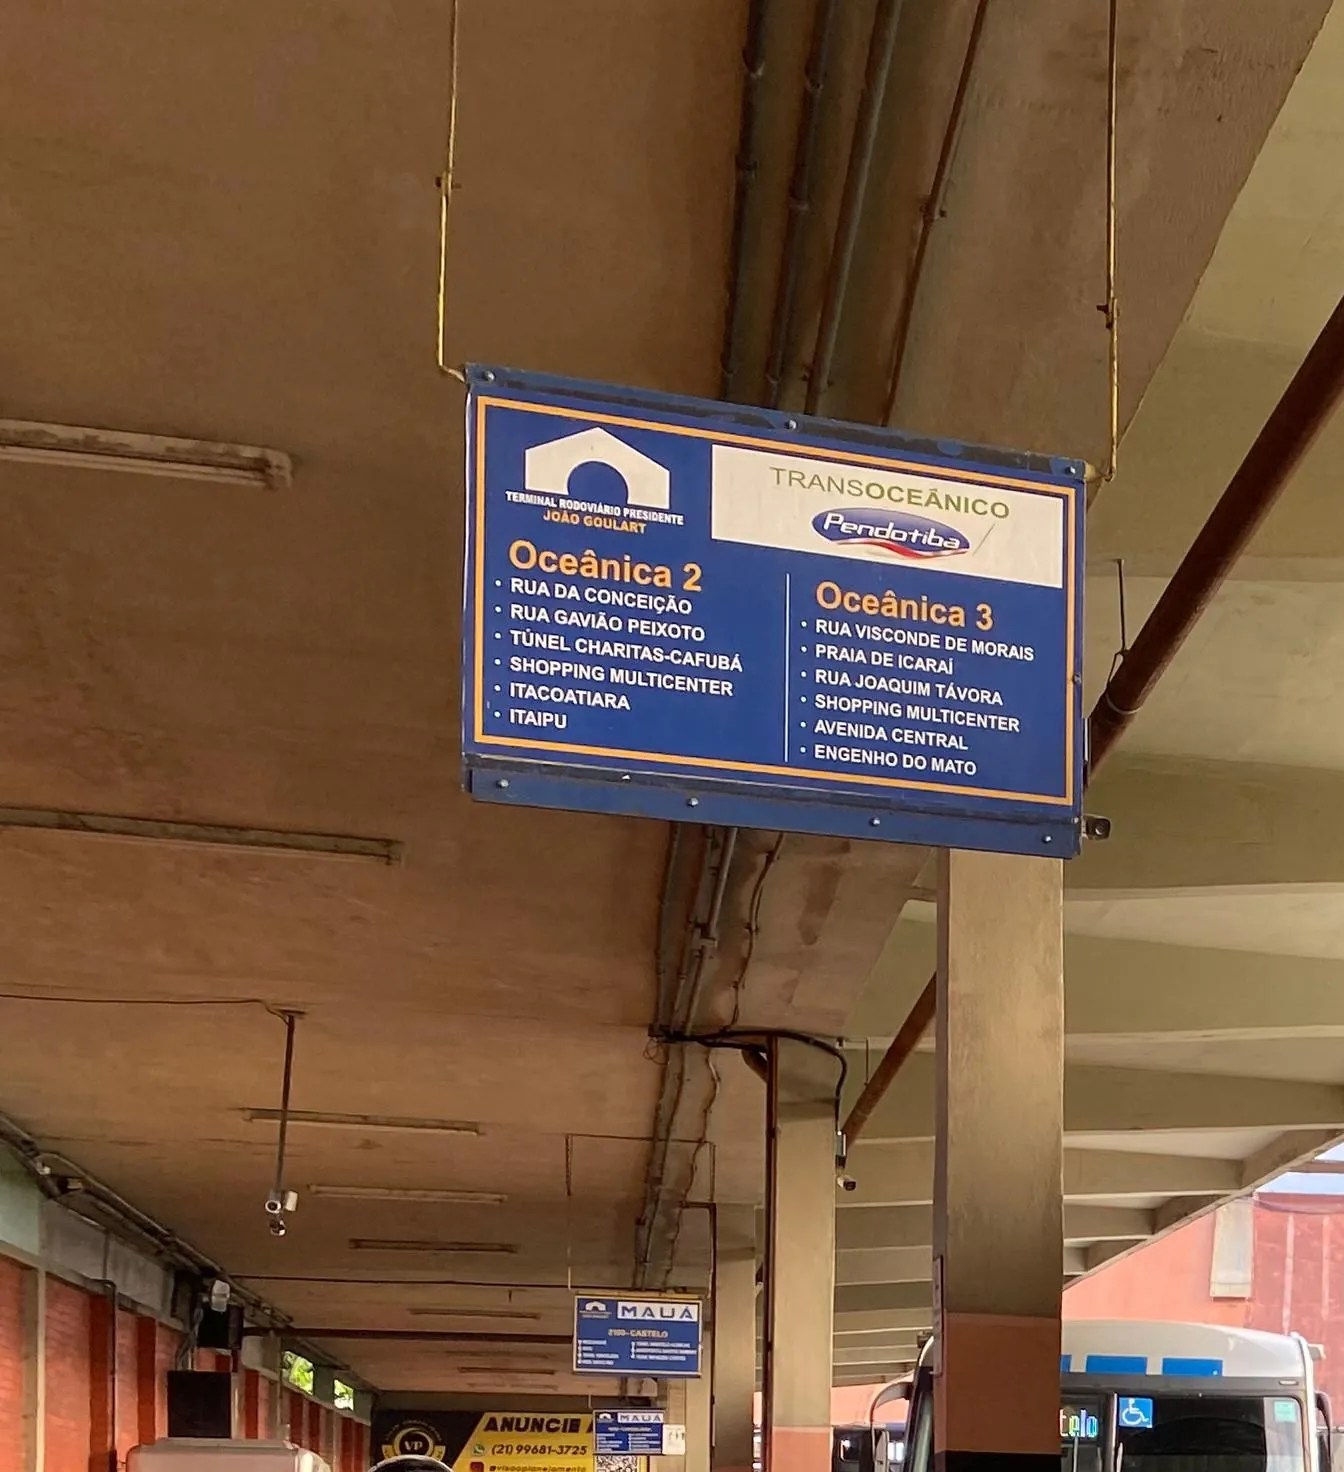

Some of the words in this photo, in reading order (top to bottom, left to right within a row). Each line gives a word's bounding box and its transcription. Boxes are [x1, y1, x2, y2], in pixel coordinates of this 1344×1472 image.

[505, 490, 557, 508] TERMINAL
[559, 498, 621, 517] RODOVIÁRIO
[623, 507, 684, 526] PRESIDENTE
[769, 466, 1010, 519] TRANSOCEÂNICO
[543, 509, 580, 526] JOÃO
[583, 515, 647, 534] GOULART
[823, 512, 961, 550] Pendotiba
[509, 539, 672, 588] Oceânica
[682, 563, 702, 592] 2
[510, 577, 550, 598] RUA
[554, 583, 581, 601] DA
[584, 588, 692, 615] CONCEIÇÃO
[816, 581, 966, 628] Oceânica
[976, 603, 994, 631] 3
[510, 603, 550, 624] RUA
[554, 610, 622, 632] GAVIÃO
[627, 618, 706, 642] PEIXOTO
[815, 619, 851, 638] RUA
[855, 624, 941, 649] VISCONDE
[945, 636, 968, 653] DE
[971, 640, 1035, 662] MORAIS
[510, 628, 571, 652] TÚNEL
[575, 638, 743, 672] CHARITAS-CAFUBÁ
[815, 644, 867, 665] PRAIA
[871, 651, 894, 668] DE
[898, 654, 954, 675] ICARAÍ
[510, 656, 605, 681] SHOPPING
[609, 668, 734, 697] MULTICENTER
[815, 668, 851, 687] RUA
[855, 674, 931, 697] JOAQUIM
[935, 682, 1003, 706] TÁVORA
[510, 682, 631, 710] ITACOATIARA
[815, 694, 902, 718] SHOPPING
[906, 705, 1020, 733] MULTICENTER
[510, 708, 567, 729] ITAIPU
[814, 719, 888, 741] AVENIDA
[891, 727, 969, 751] CENTRAL
[814, 744, 898, 768] ENGENHO
[902, 753, 927, 770] DO
[931, 757, 977, 777] MATO
[621, 1305, 693, 1319] MAUÁ
[484, 1416, 582, 1433] ANUNCIE
[404, 1440, 423, 1451] VP
[491, 1444, 513, 1456] (21)
[516, 1444, 588, 1456] 99681-3725
